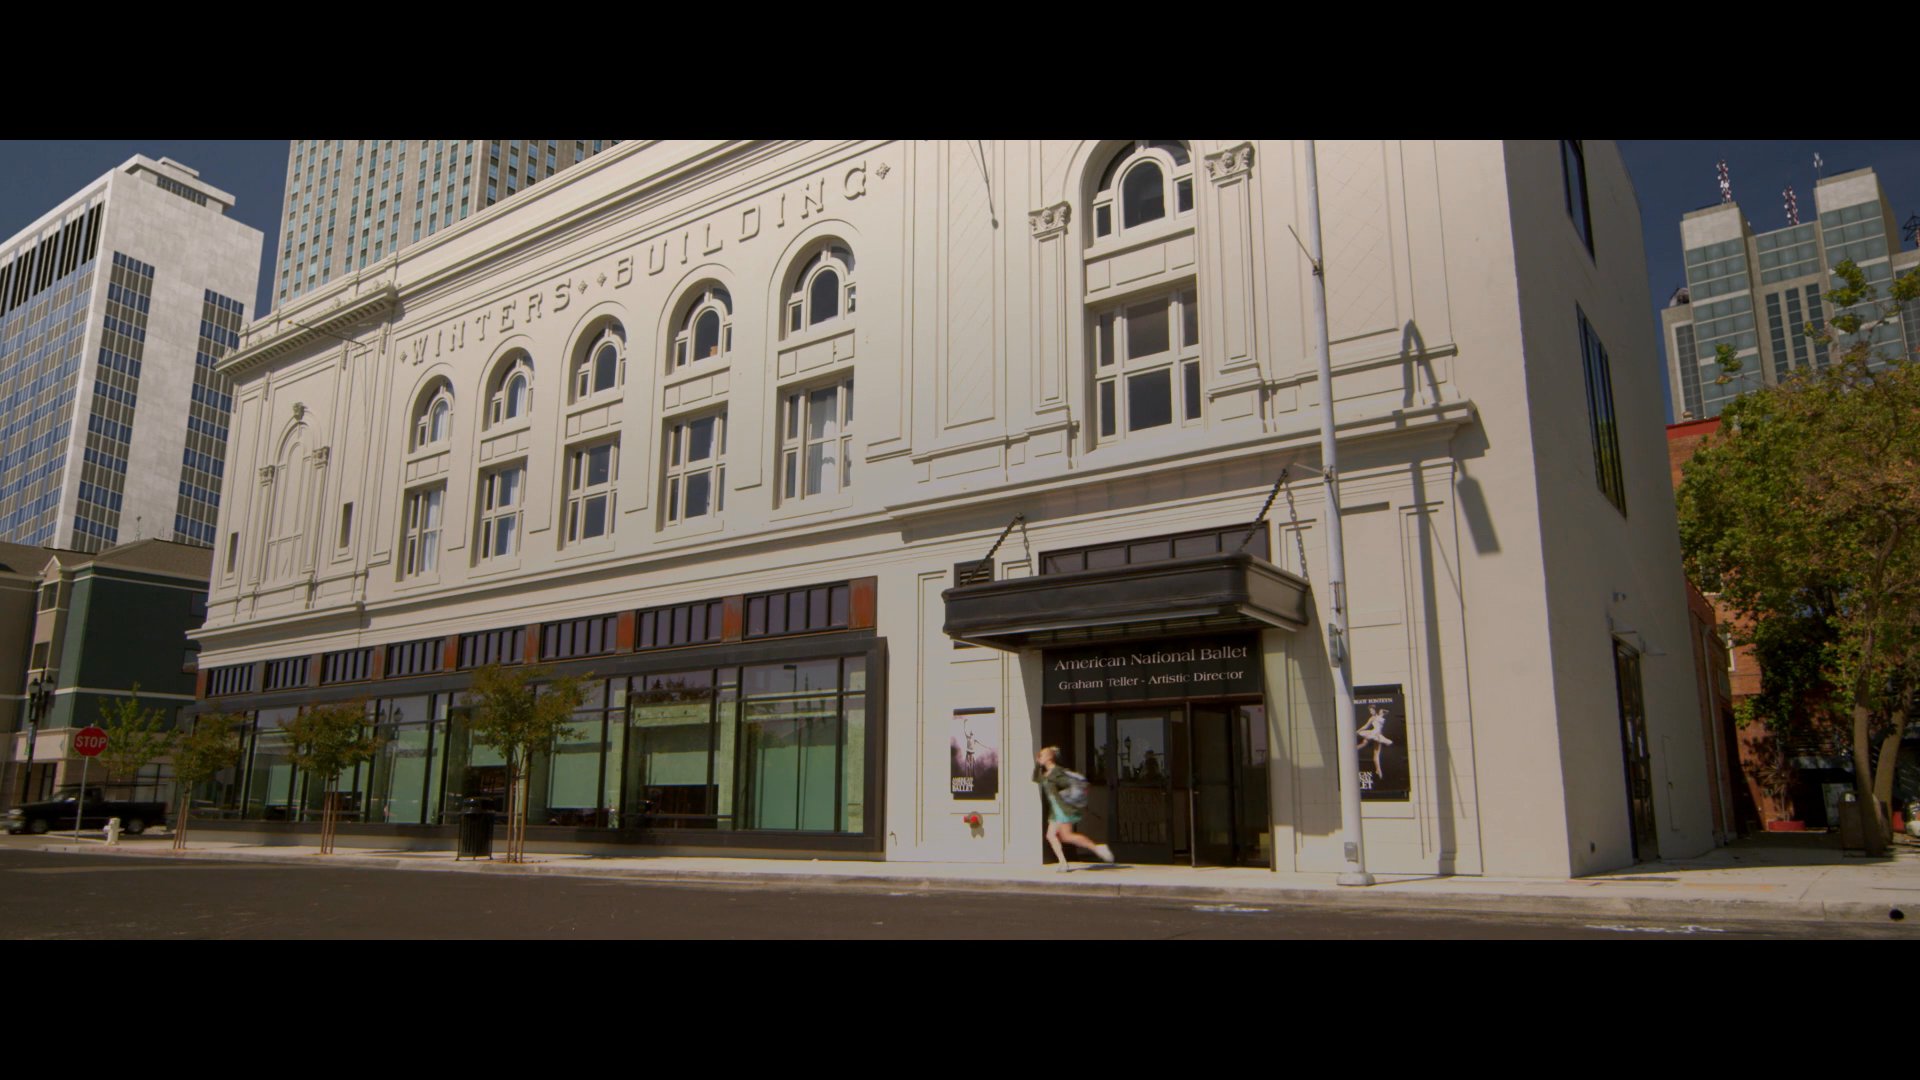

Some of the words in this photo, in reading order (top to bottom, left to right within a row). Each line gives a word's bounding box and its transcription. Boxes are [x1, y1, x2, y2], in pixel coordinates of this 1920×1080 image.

[412, 282, 573, 366] WINTERS
[614, 160, 868, 289] BUILDING
[1054, 655, 1126, 671] American
[1130, 649, 1196, 665] National
[1200, 646, 1248, 661] Ballet
[1058, 678, 1103, 691] Graham
[1106, 677, 1139, 688] Teller
[1148, 673, 1191, 685] Artistic
[1193, 670, 1244, 683] Director
[76, 735, 107, 748] STOP
